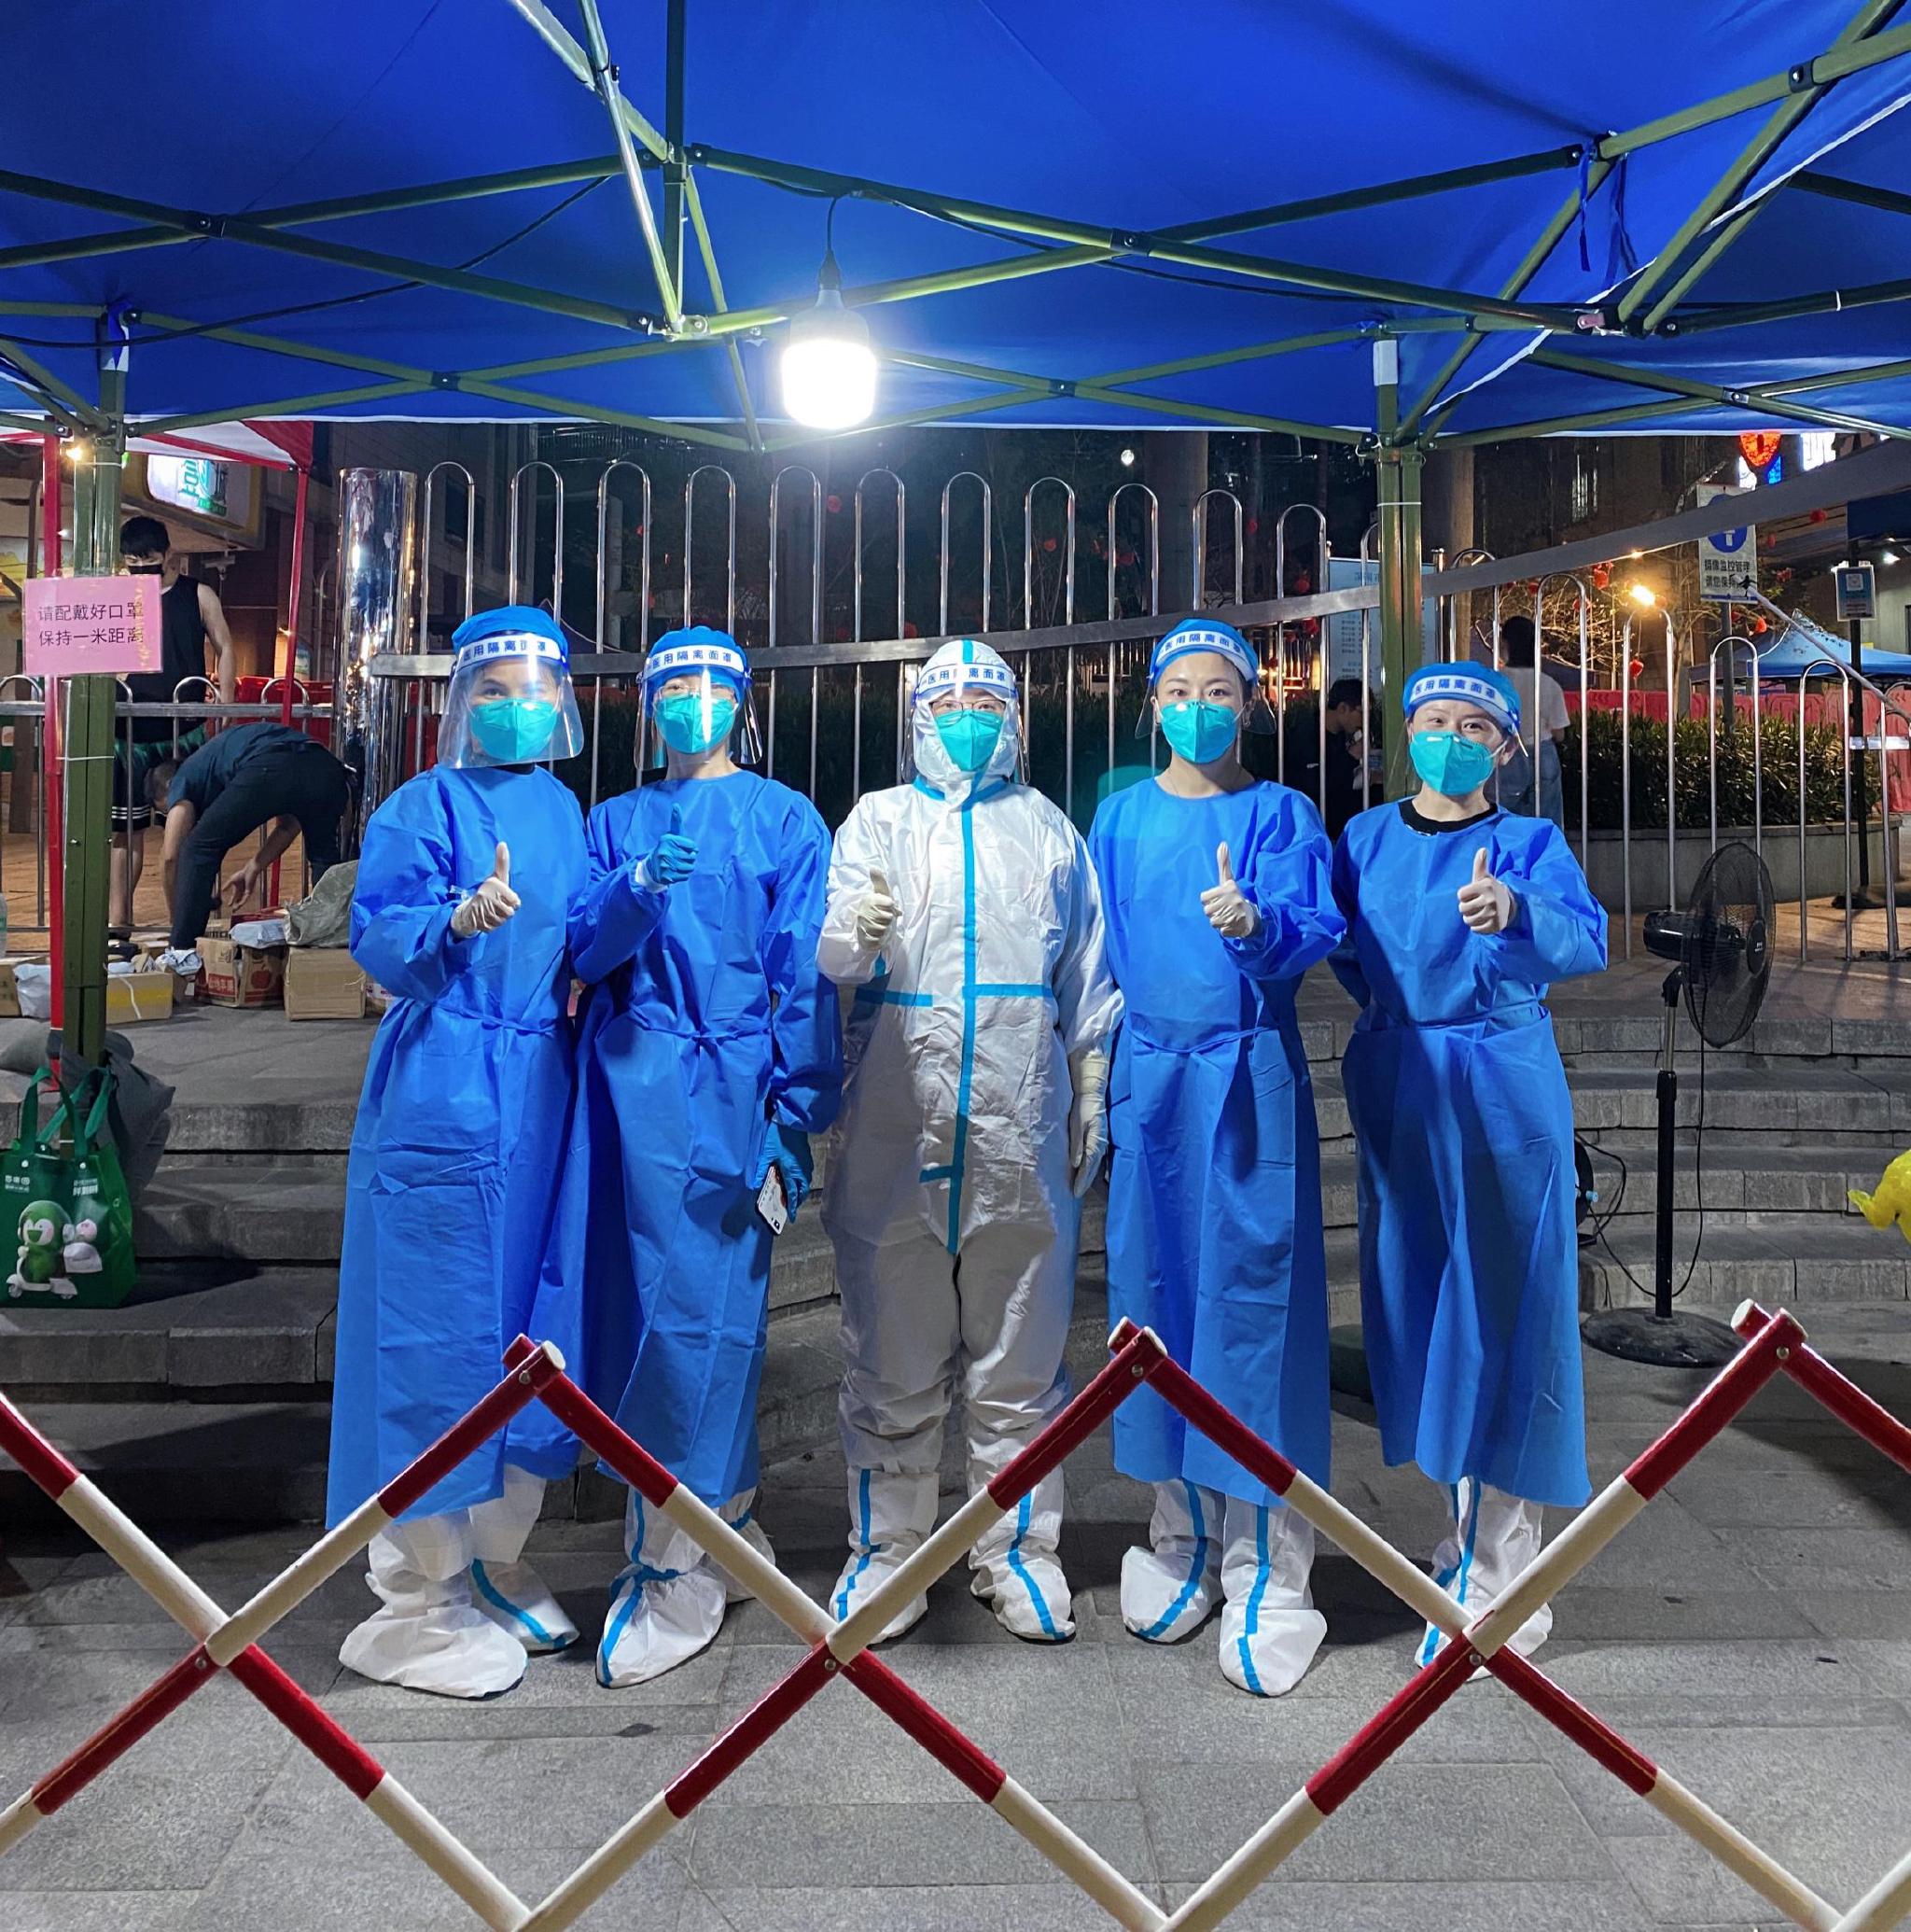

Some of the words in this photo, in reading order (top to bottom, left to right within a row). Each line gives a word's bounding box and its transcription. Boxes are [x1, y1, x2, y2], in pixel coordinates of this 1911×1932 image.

[38, 602, 144, 622] 请配戴好口罩
[38, 627, 144, 647] 保持一米距离
[928, 666, 1006, 685] 医用离面罩
